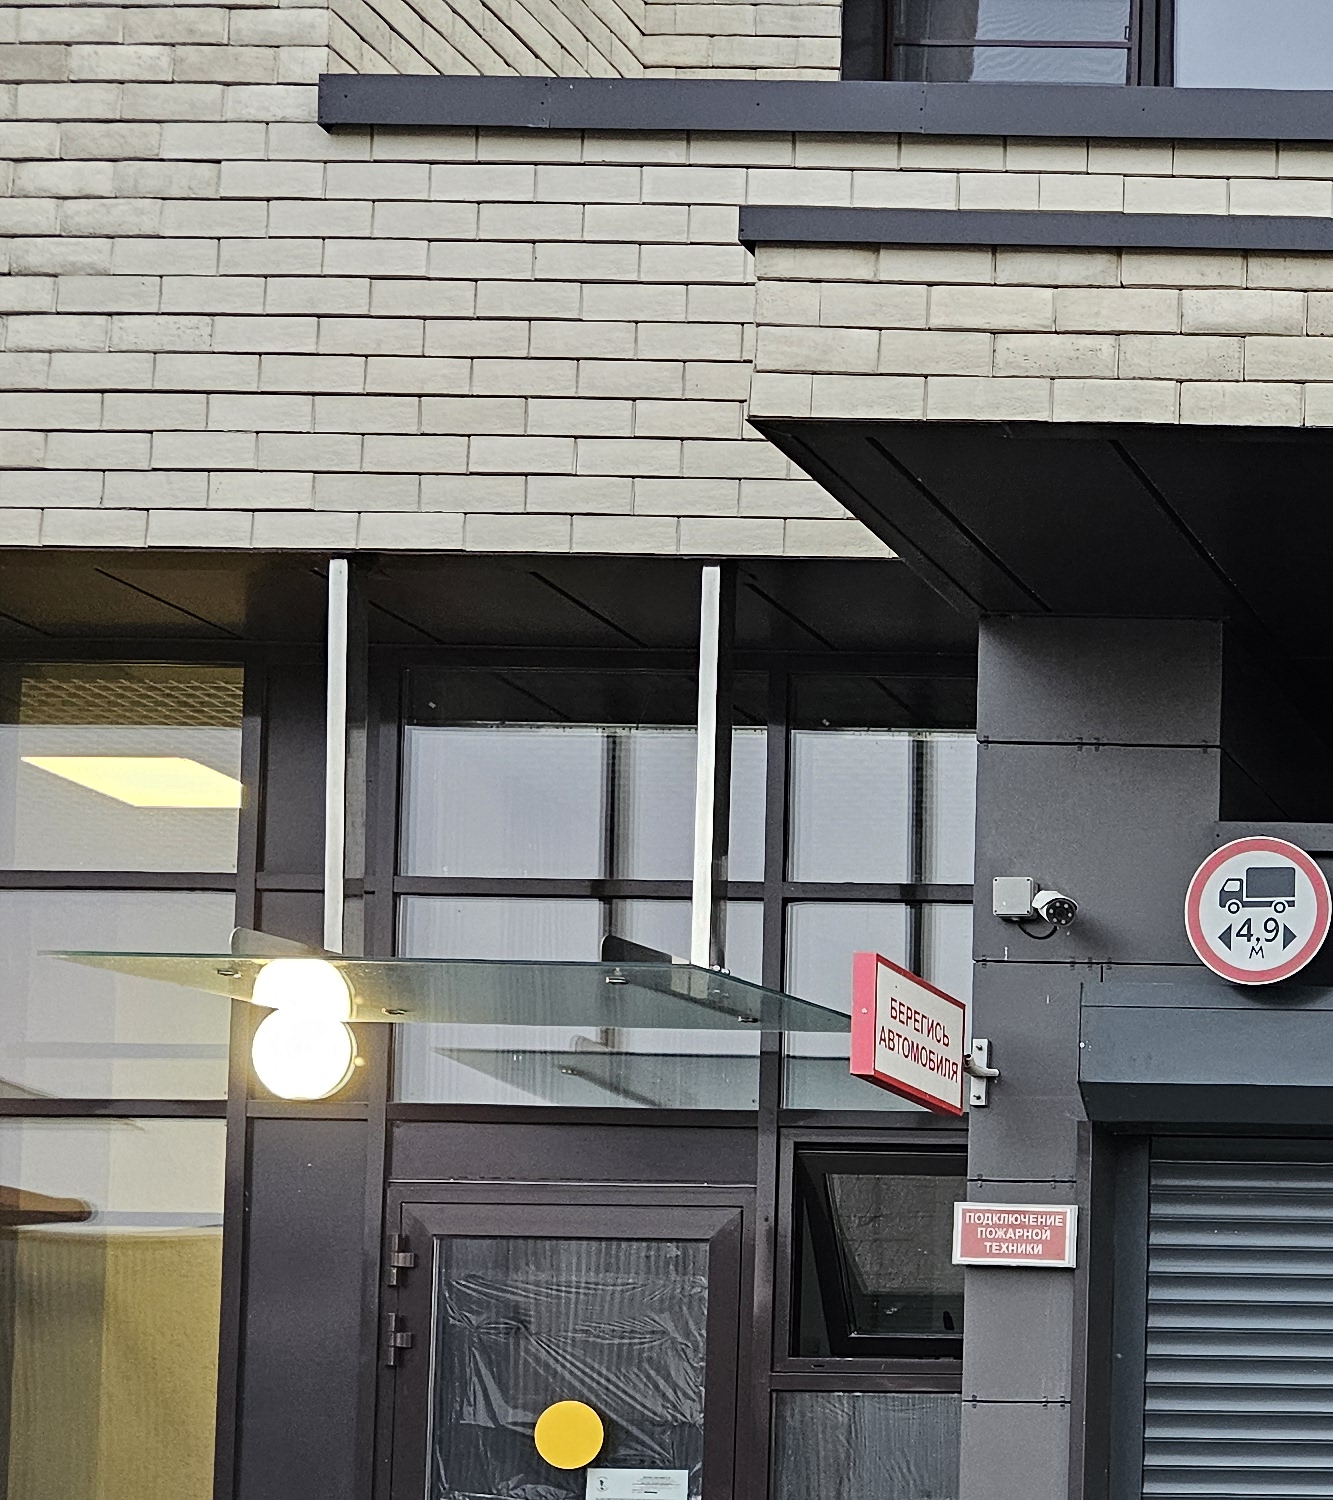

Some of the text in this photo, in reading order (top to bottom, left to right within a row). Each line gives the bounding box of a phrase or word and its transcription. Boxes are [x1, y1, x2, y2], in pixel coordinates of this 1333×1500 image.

[1235, 916, 1281, 947] 4,9
[890, 996, 951, 1048] БЕРЕГИСЬ
[878, 1025, 960, 1084] АВТОМОБИЛЯ
[965, 1212, 1064, 1227] ПОДКЛЮЧЕНИЕ
[977, 1226, 1051, 1240] ПОЖАРНОЙ
[984, 1241, 1043, 1255] ТЕХНИКИ
